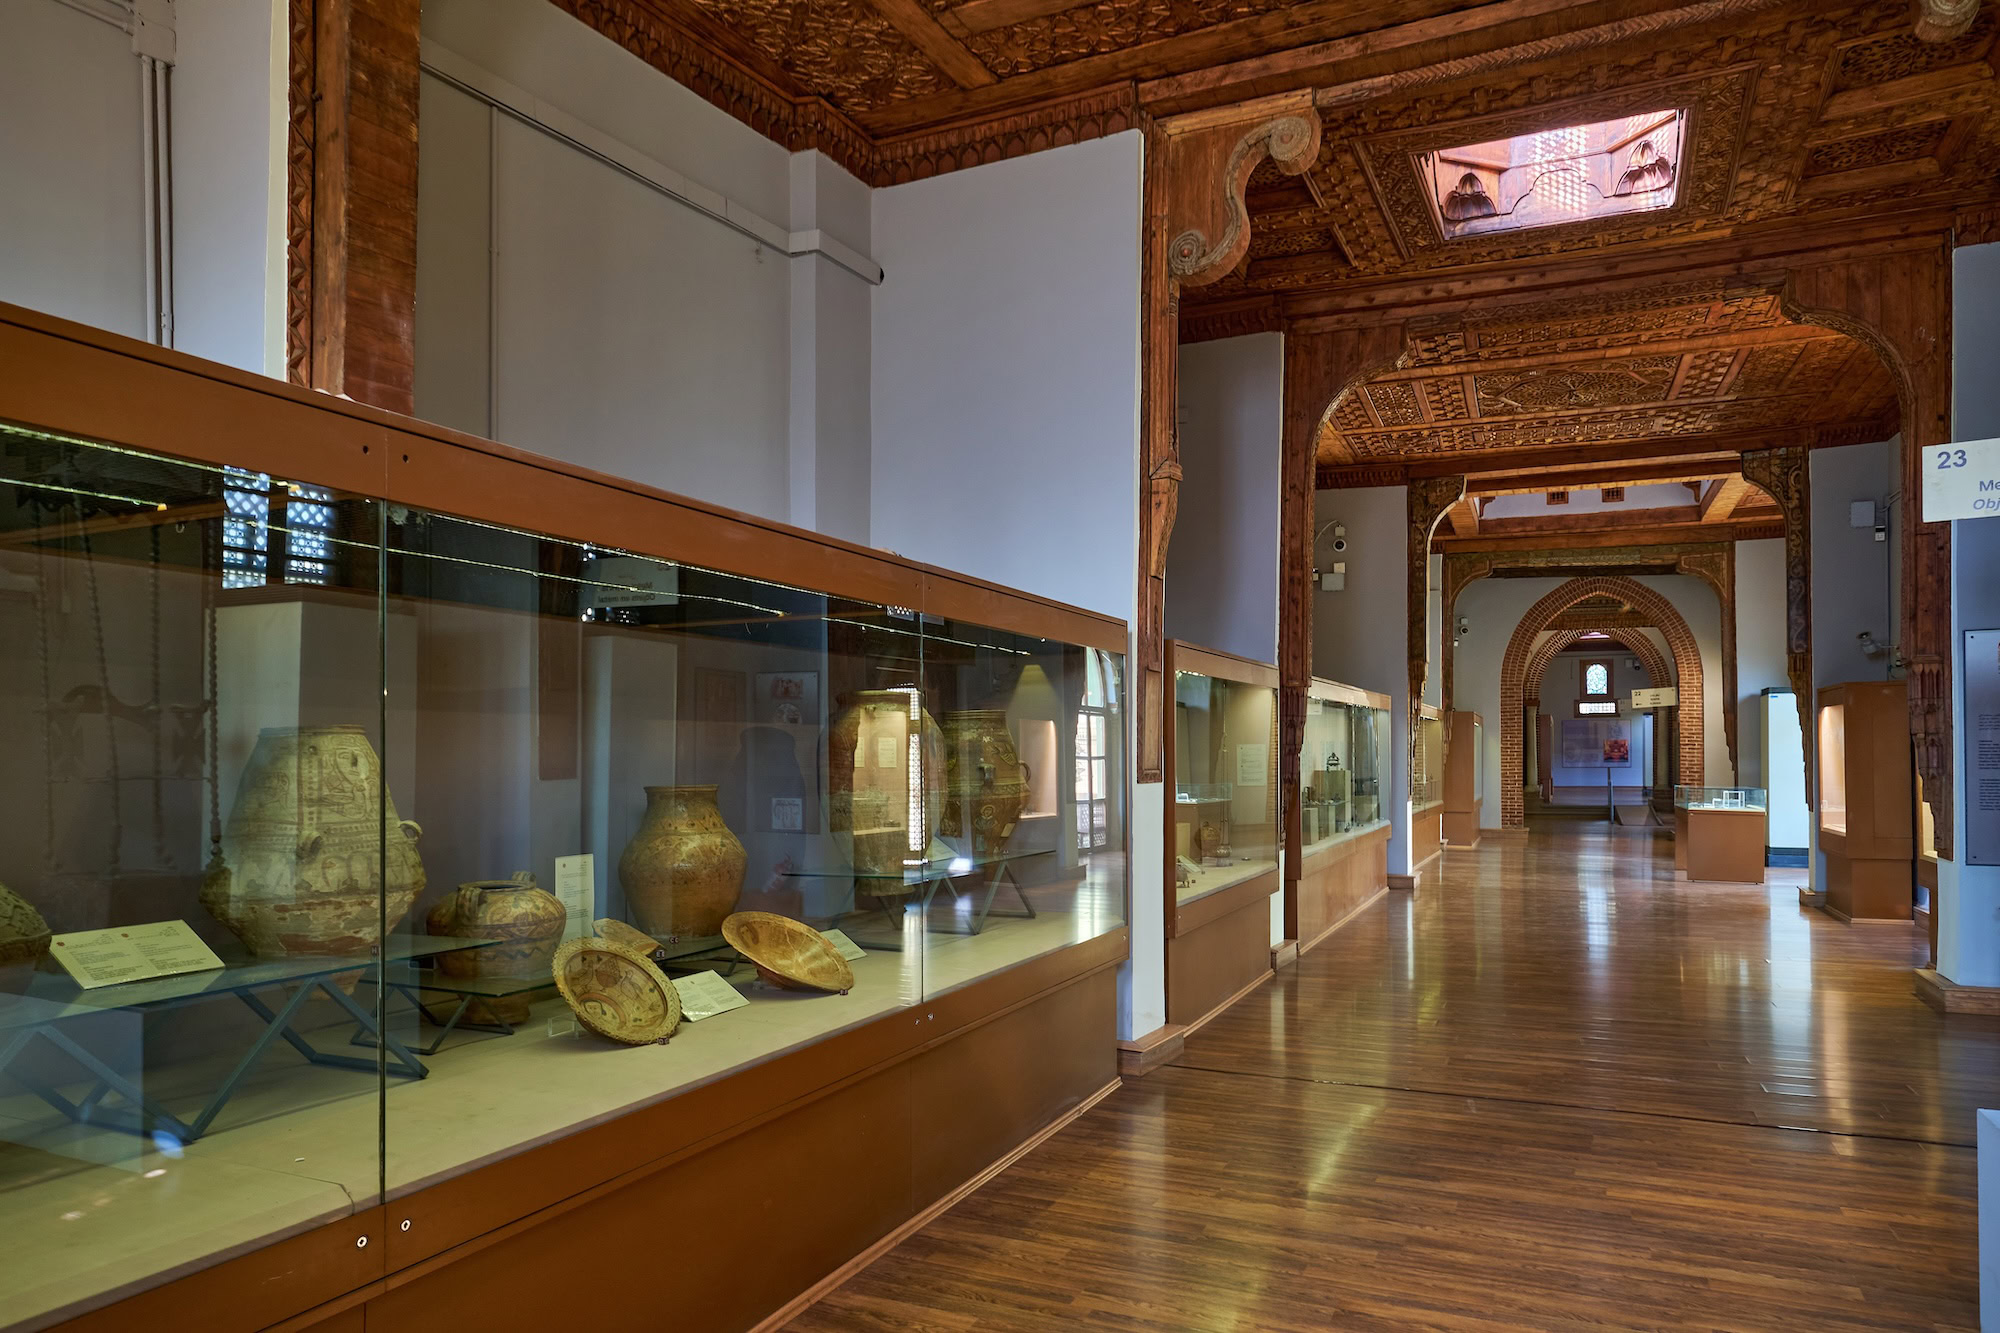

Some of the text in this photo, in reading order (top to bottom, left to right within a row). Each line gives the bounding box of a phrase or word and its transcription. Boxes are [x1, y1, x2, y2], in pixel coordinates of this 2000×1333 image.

[1937, 449, 1967, 469] 23
[1979, 479, 2000, 492] Me
[1973, 498, 2000, 511] Obj
